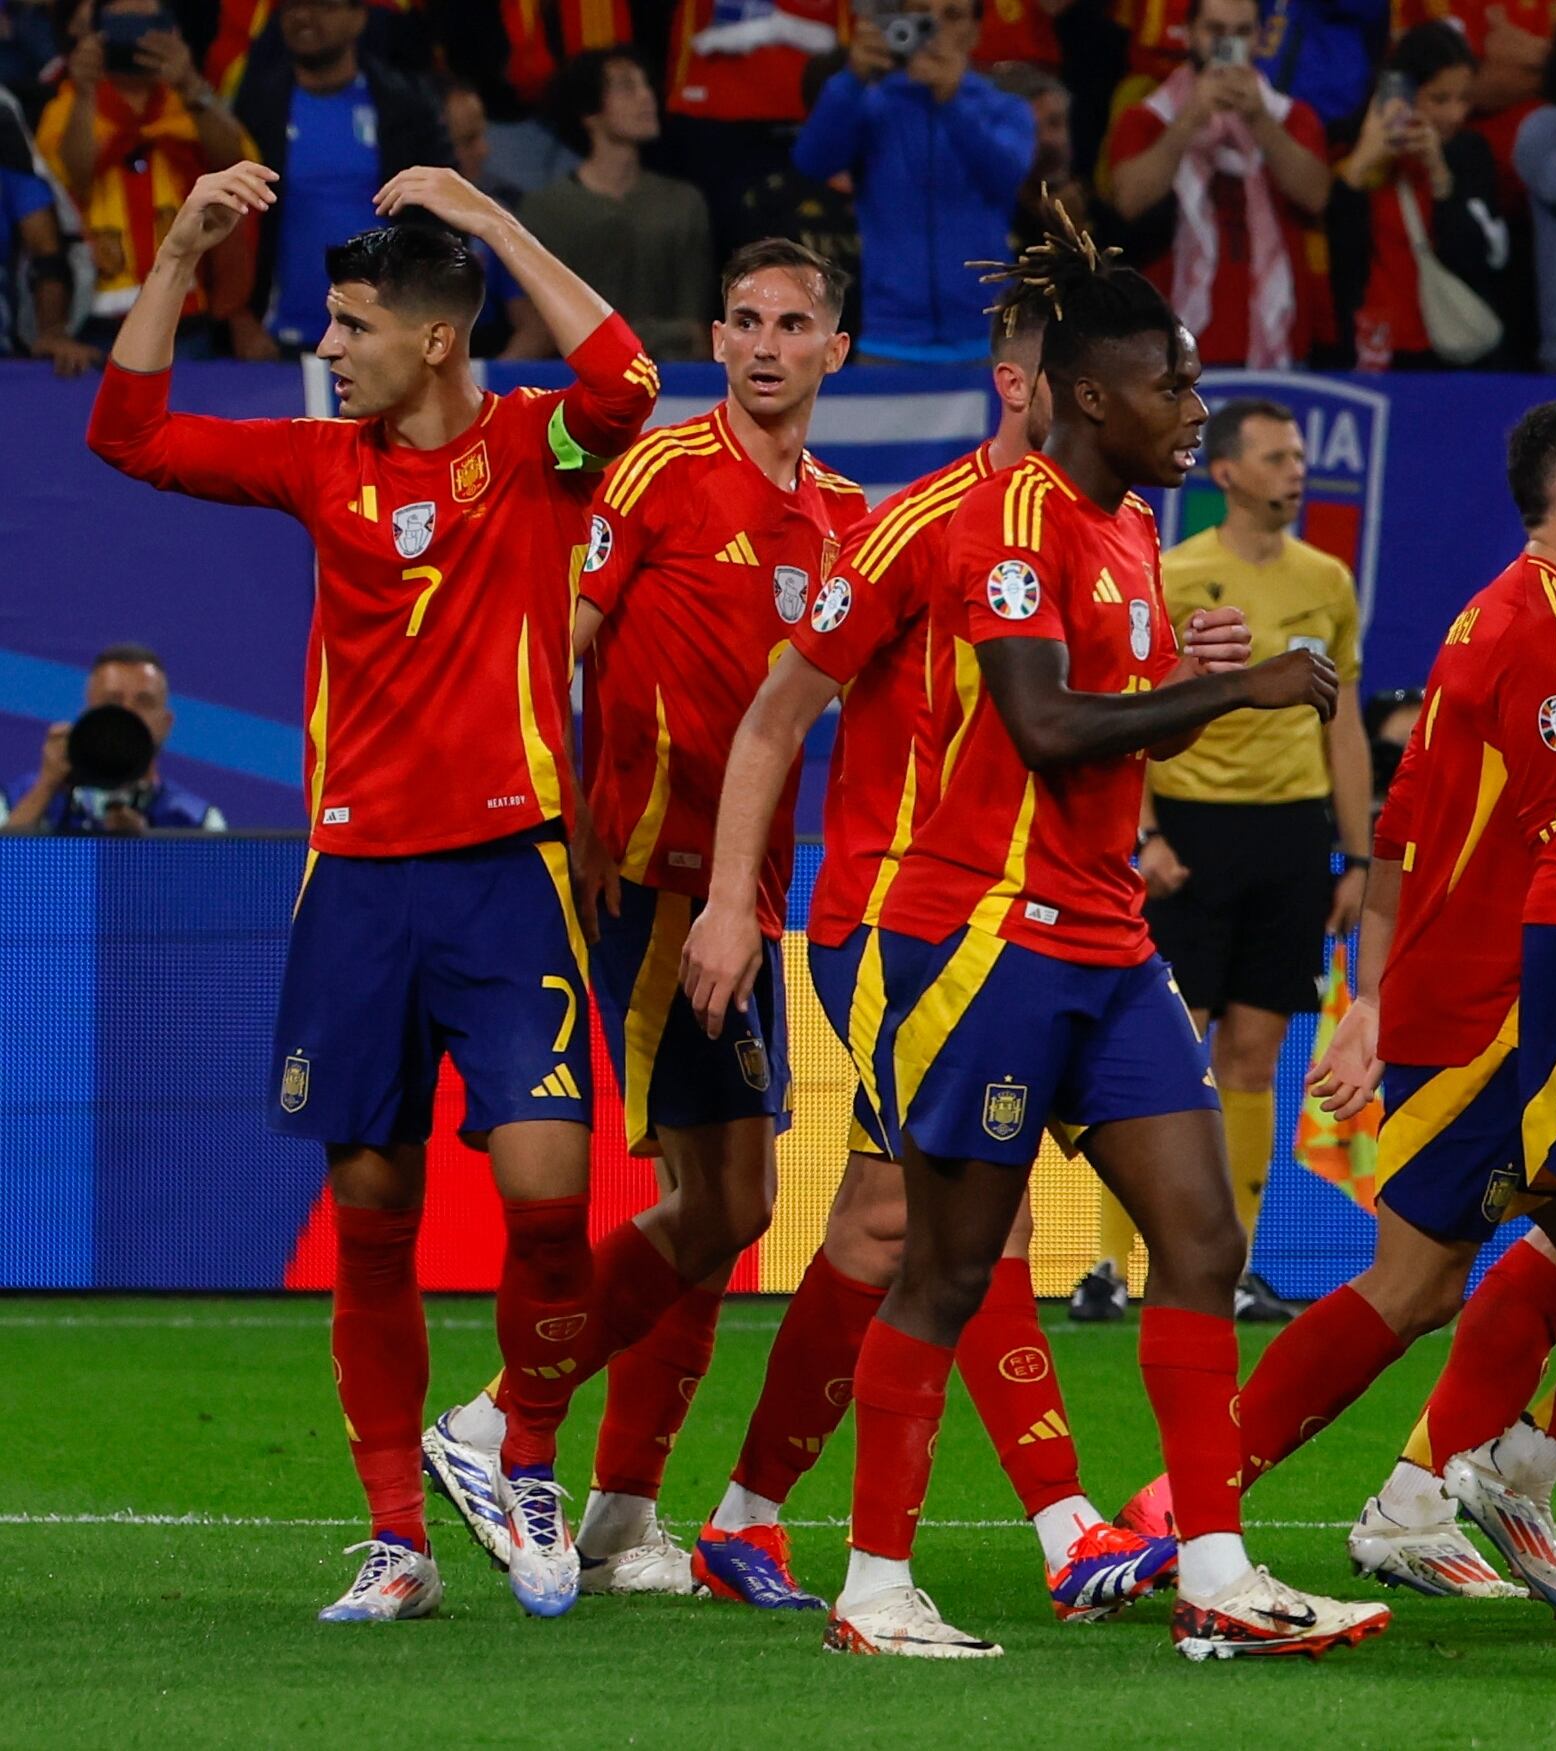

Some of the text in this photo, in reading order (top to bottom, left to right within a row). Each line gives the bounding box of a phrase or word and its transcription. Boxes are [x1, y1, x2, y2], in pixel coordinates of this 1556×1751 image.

[402, 565, 443, 637] 7
[487, 795, 526, 809] HEAT.RDY
[541, 974, 578, 1053] 7
